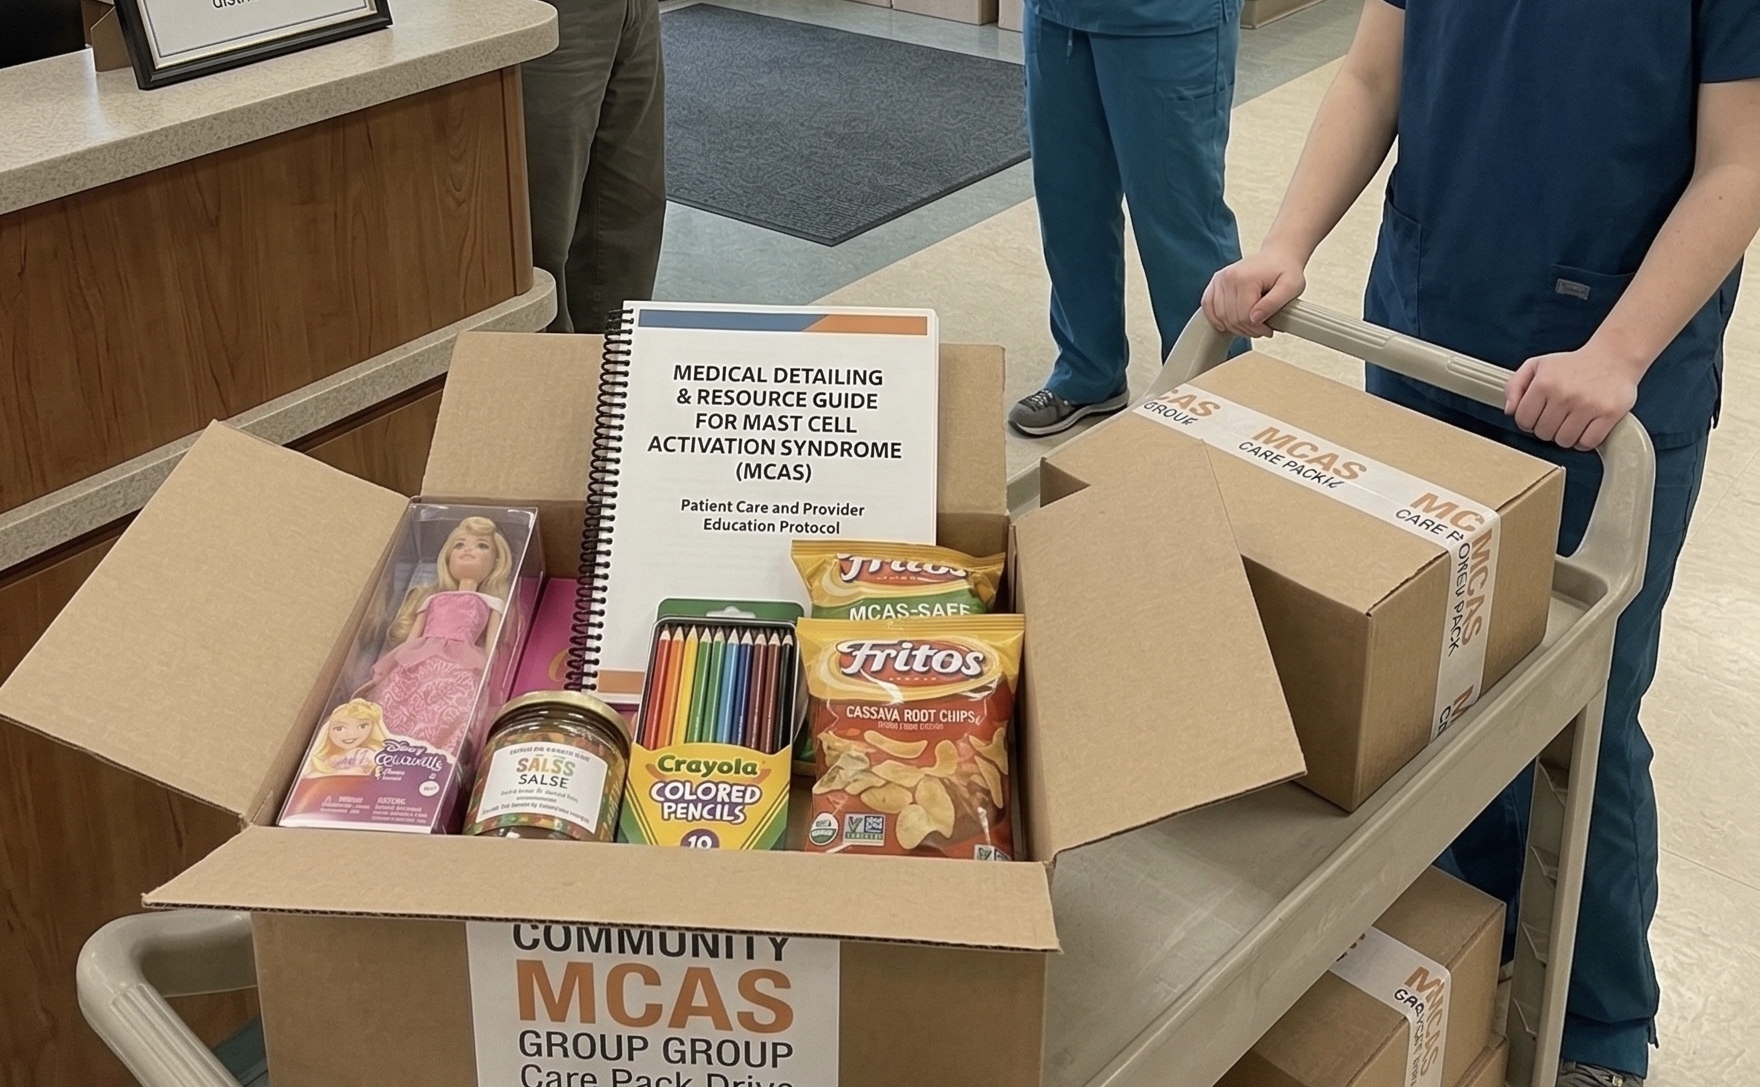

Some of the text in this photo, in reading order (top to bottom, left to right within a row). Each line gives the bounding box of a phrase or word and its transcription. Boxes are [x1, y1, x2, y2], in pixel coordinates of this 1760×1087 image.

[673, 364, 884, 386] MEDICAL DETAILING
[676, 388, 878, 410] & RESOURCE GUIDE
[695, 413, 858, 433] FOR MAST CELL
[647, 435, 902, 459] ACTIVATION SYNDROME
[1238, 441, 1285, 465] CARE
[1251, 426, 1368, 480] MCAS
[736, 462, 812, 484] (MCAS)
[681, 499, 865, 516] Patient Care and Provider
[703, 518, 840, 535] Education Protocol
[1395, 508, 1448, 535] CARE
[1461, 527, 1493, 646] MCAS
[836, 640, 984, 676] Fritos
[846, 705, 976, 724] CASSAVA ROOT CHIPS
[657, 755, 758, 777] Crayola
[518, 774, 570, 789] SALSE
[650, 781, 761, 804] COLORED
[662, 802, 746, 824] PENCILS
[512, 923, 790, 962] COMMUNITY
[516, 958, 795, 1034] MCAS
[518, 1029, 794, 1069] GROUP GROUP
[520, 1064, 598, 1087] Care
